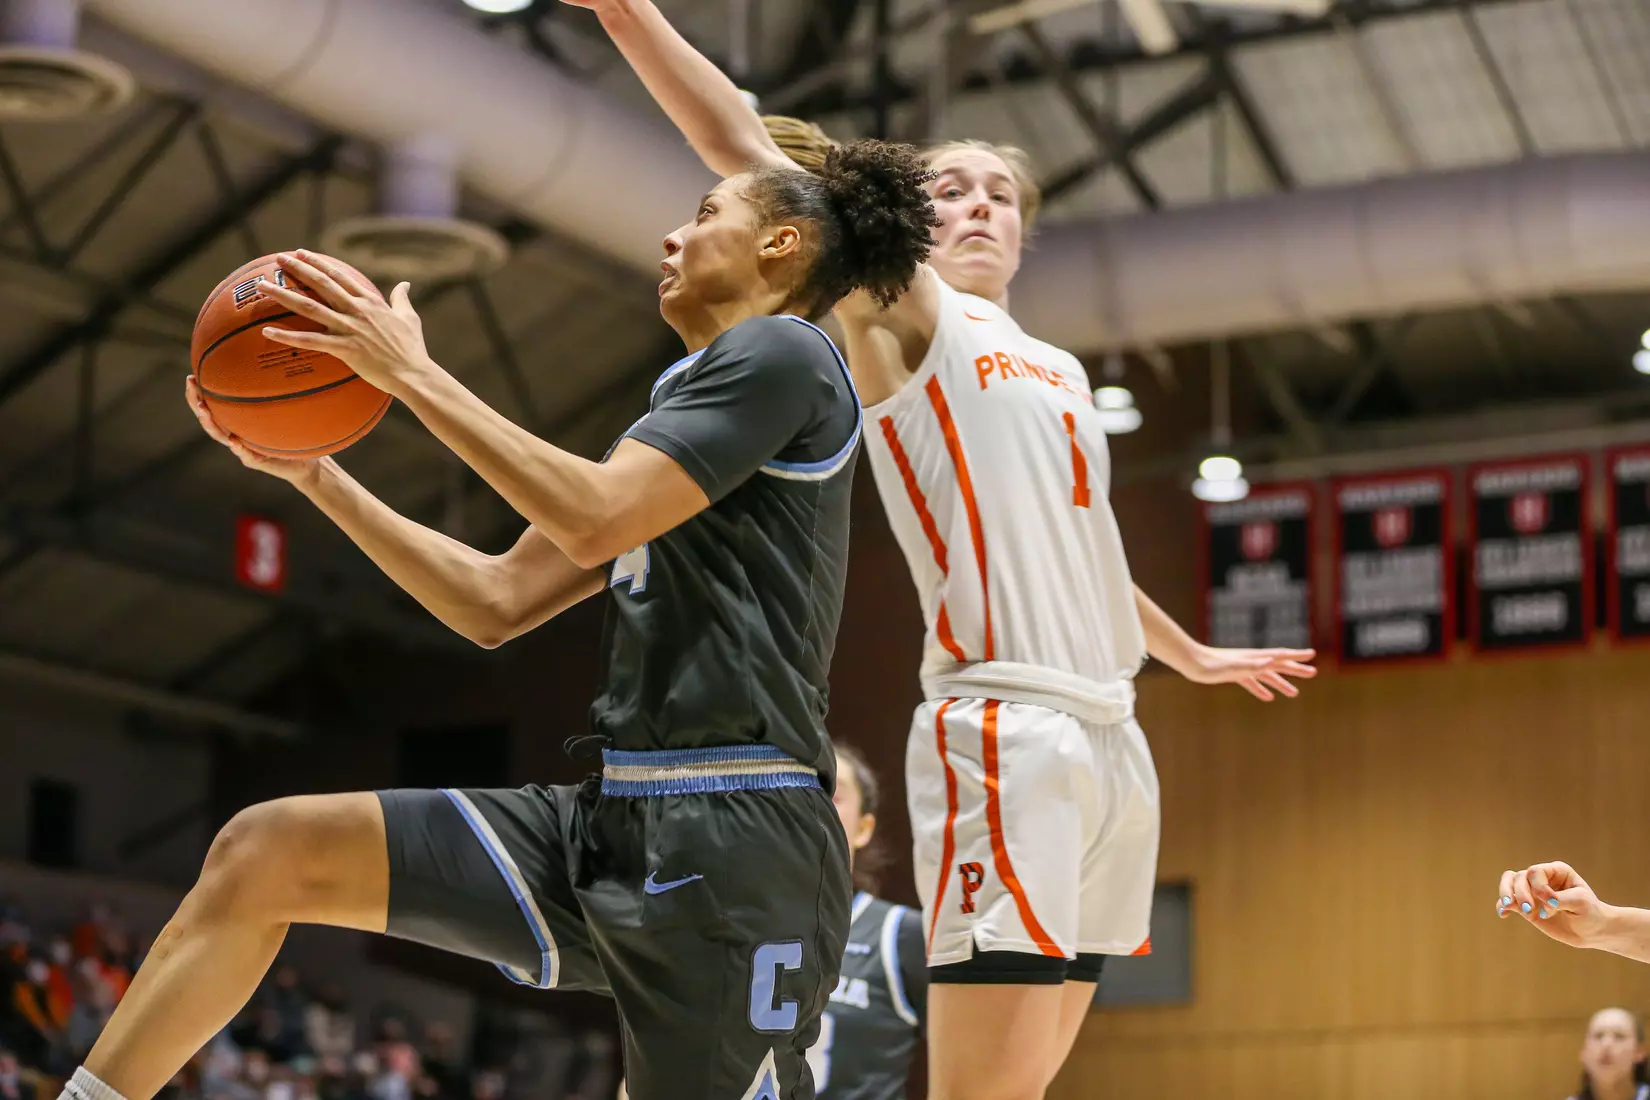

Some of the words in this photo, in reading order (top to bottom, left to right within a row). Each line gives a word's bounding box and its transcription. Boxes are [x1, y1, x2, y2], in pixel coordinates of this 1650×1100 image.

[1062, 411, 1091, 508] 1
[249, 521, 281, 584] 3
[958, 861, 986, 914] P
[749, 939, 804, 1033] C
